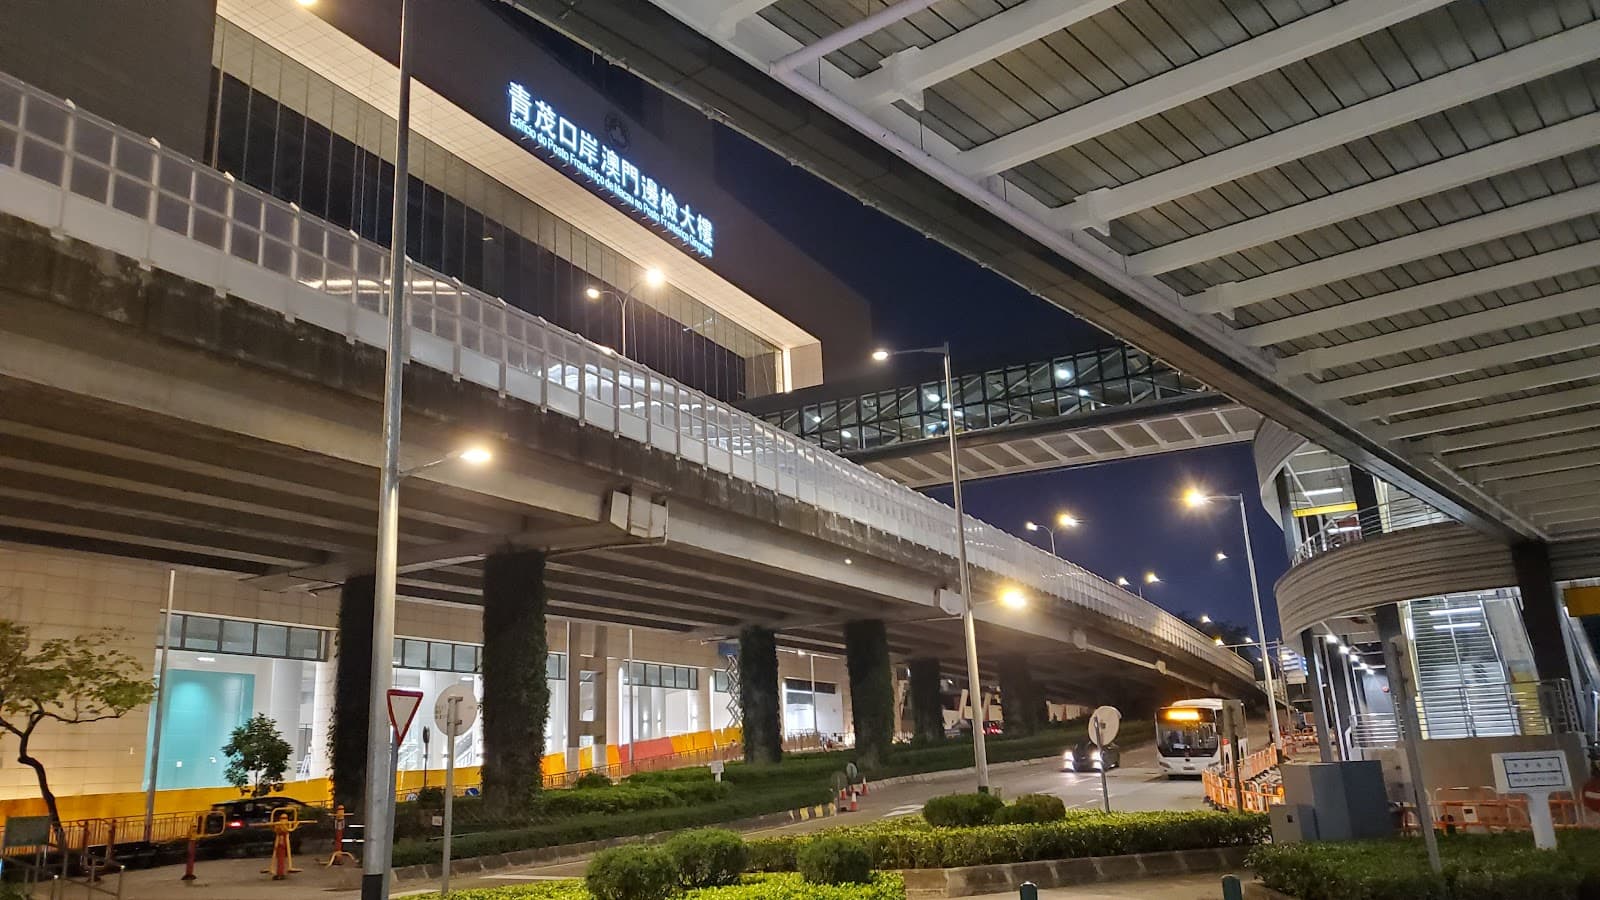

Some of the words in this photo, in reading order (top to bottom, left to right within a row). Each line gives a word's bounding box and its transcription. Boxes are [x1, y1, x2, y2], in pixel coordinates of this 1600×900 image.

[537, 133, 548, 147] do
[548, 138, 570, 161] Posto
[570, 152, 605, 185] Fronteiriço
[605, 178, 614, 191] de
[614, 183, 635, 205] Macau
[635, 199, 643, 210] no
[643, 203, 660, 222] Posto
